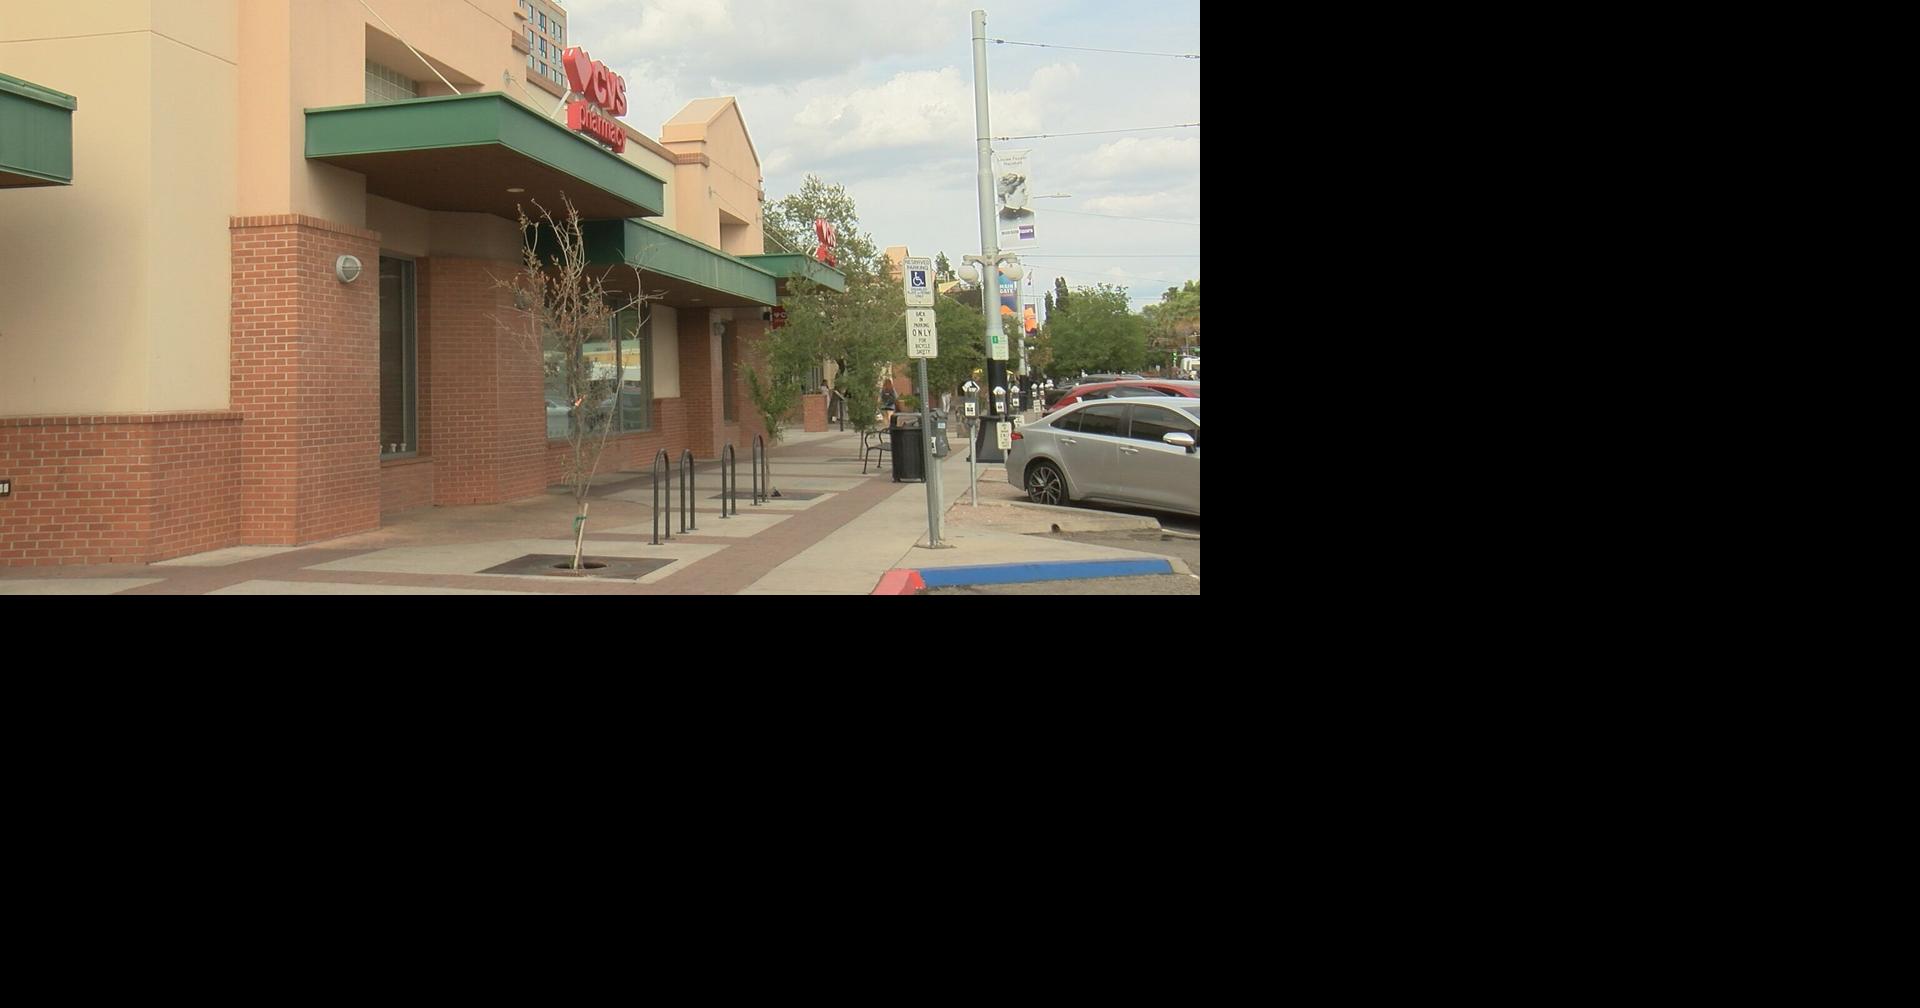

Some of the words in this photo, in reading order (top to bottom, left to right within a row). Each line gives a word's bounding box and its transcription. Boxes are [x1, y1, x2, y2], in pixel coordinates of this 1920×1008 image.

[593, 60, 628, 117] CVS
[580, 104, 626, 149] pharmacy
[912, 329, 931, 337] ONLY
